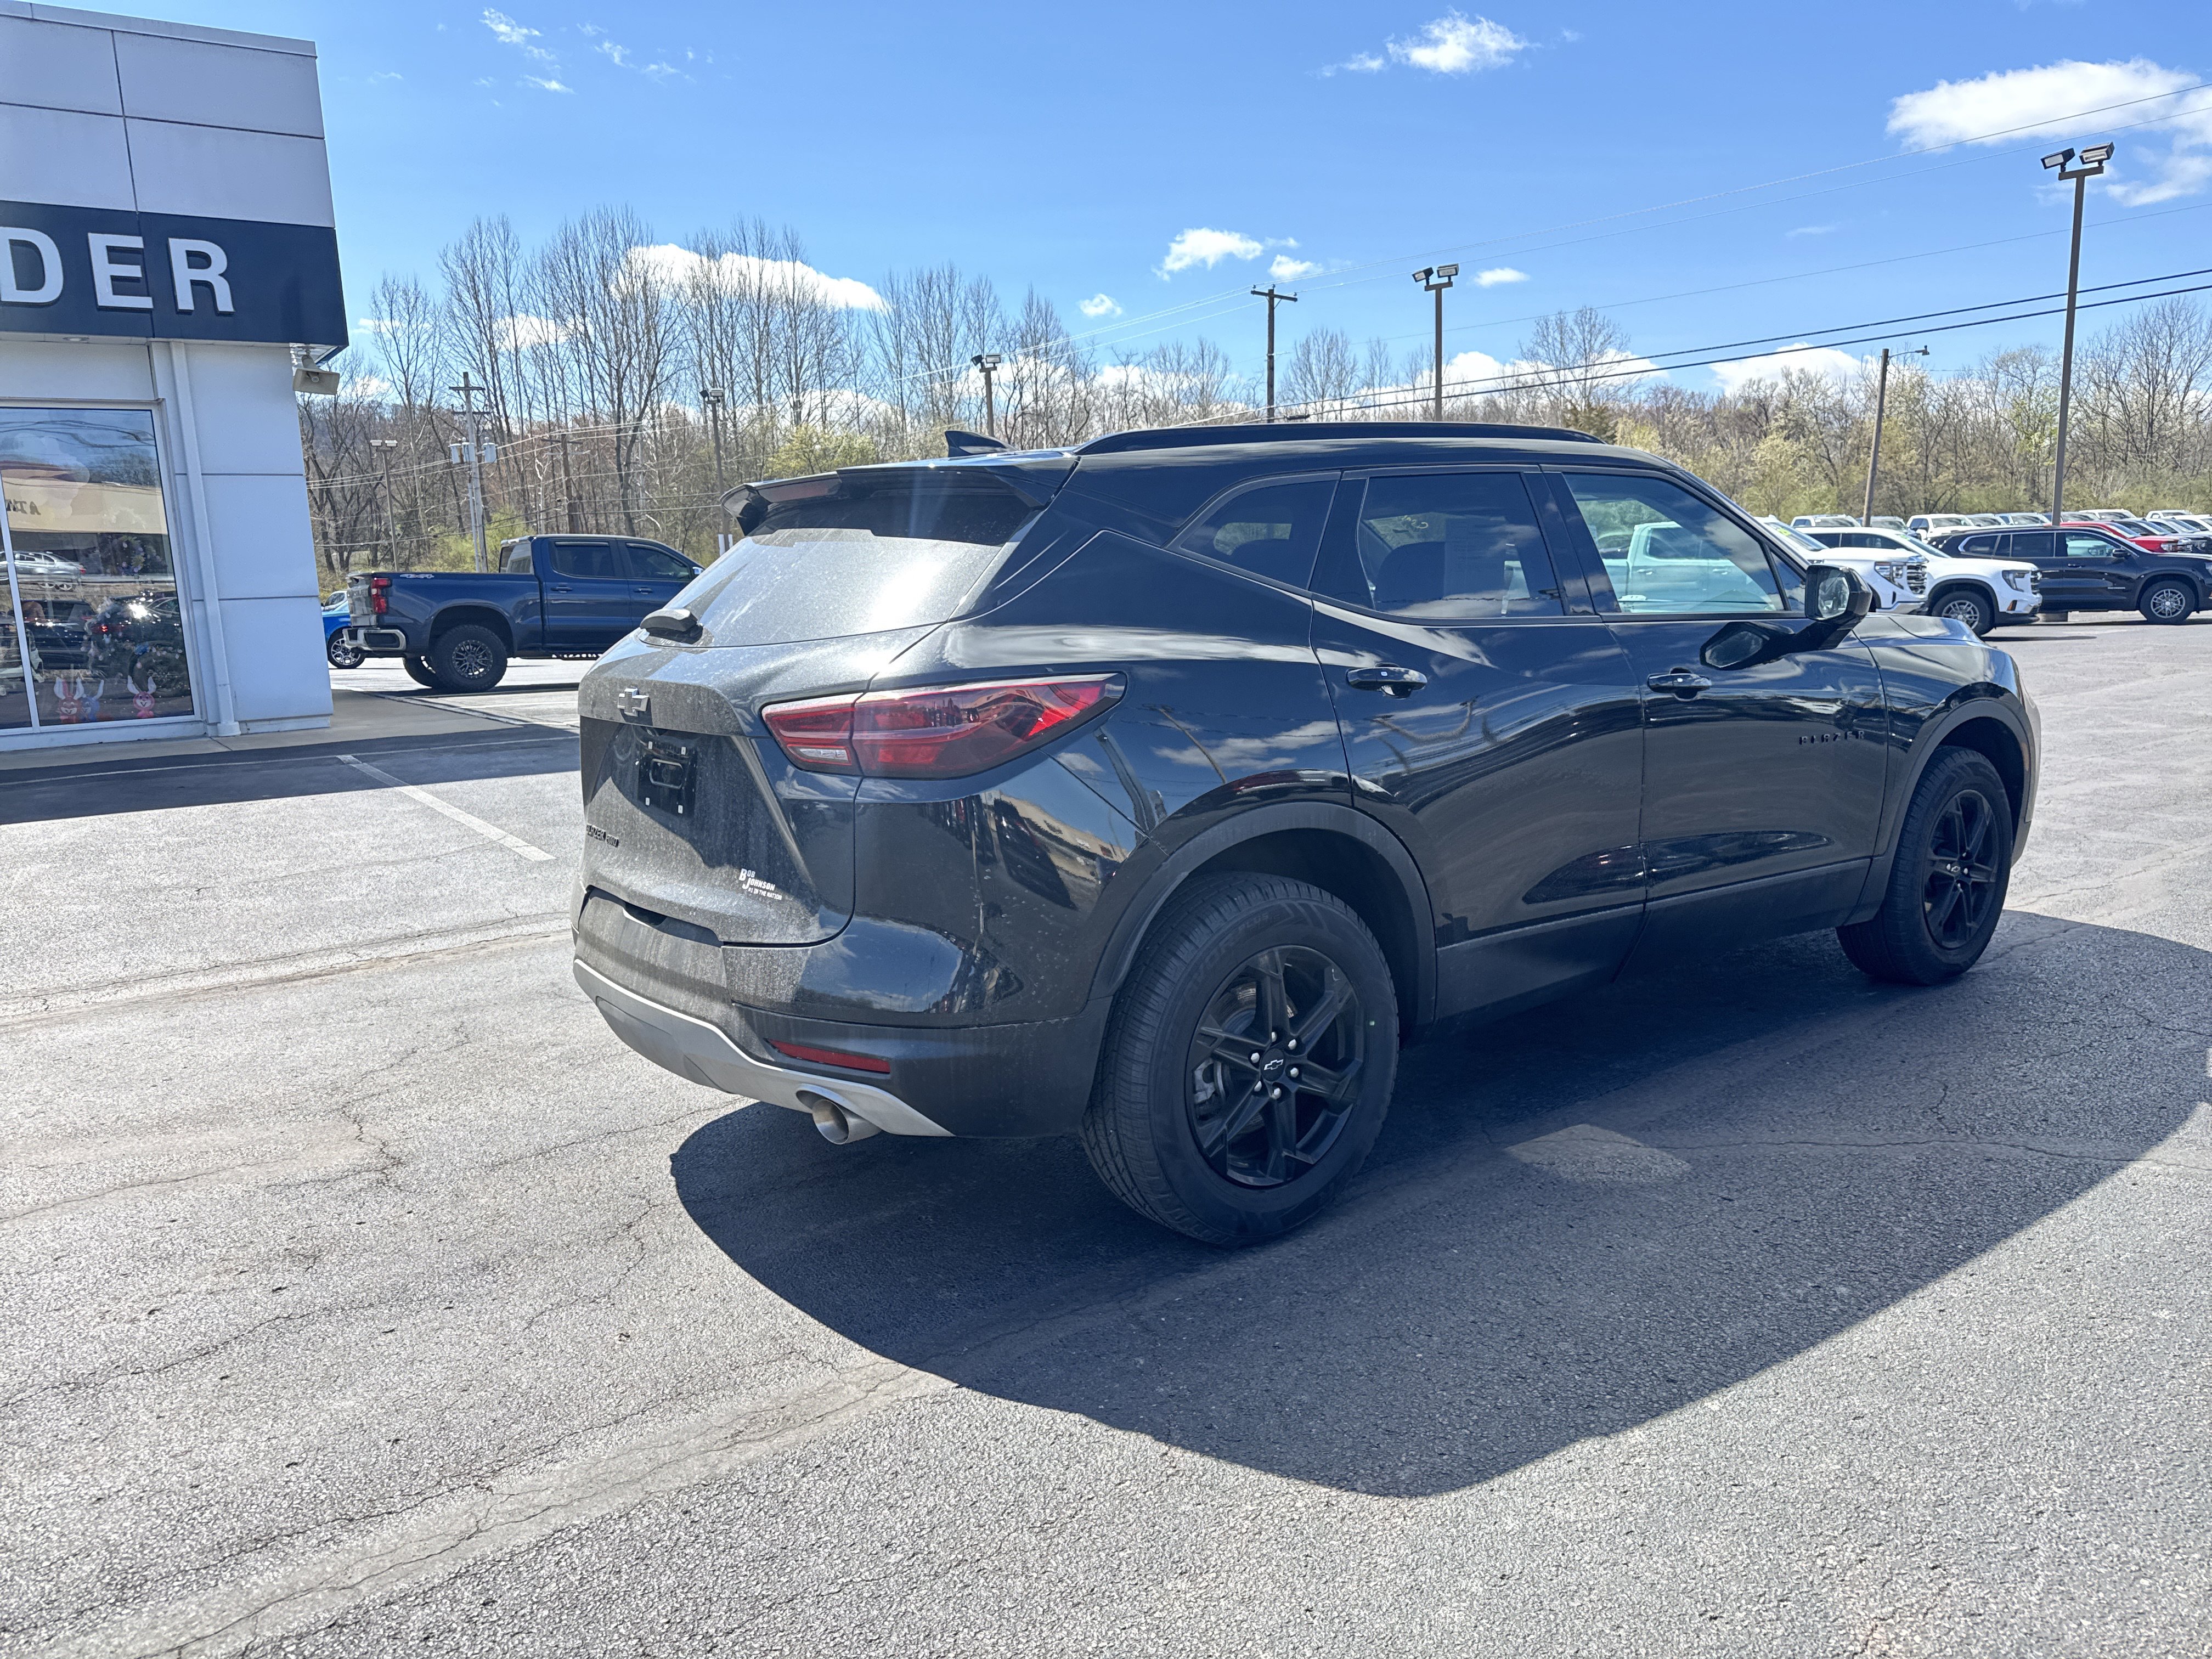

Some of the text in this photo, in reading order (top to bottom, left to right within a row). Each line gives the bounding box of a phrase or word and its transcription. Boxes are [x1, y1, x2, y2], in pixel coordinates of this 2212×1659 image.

[0, 227, 235, 312] DER
[1799, 730, 1865, 745] BLAZER
[738, 868, 756, 881] BOB
[742, 877, 776, 891] JOHNSON
[766, 891, 782, 901] NATION
